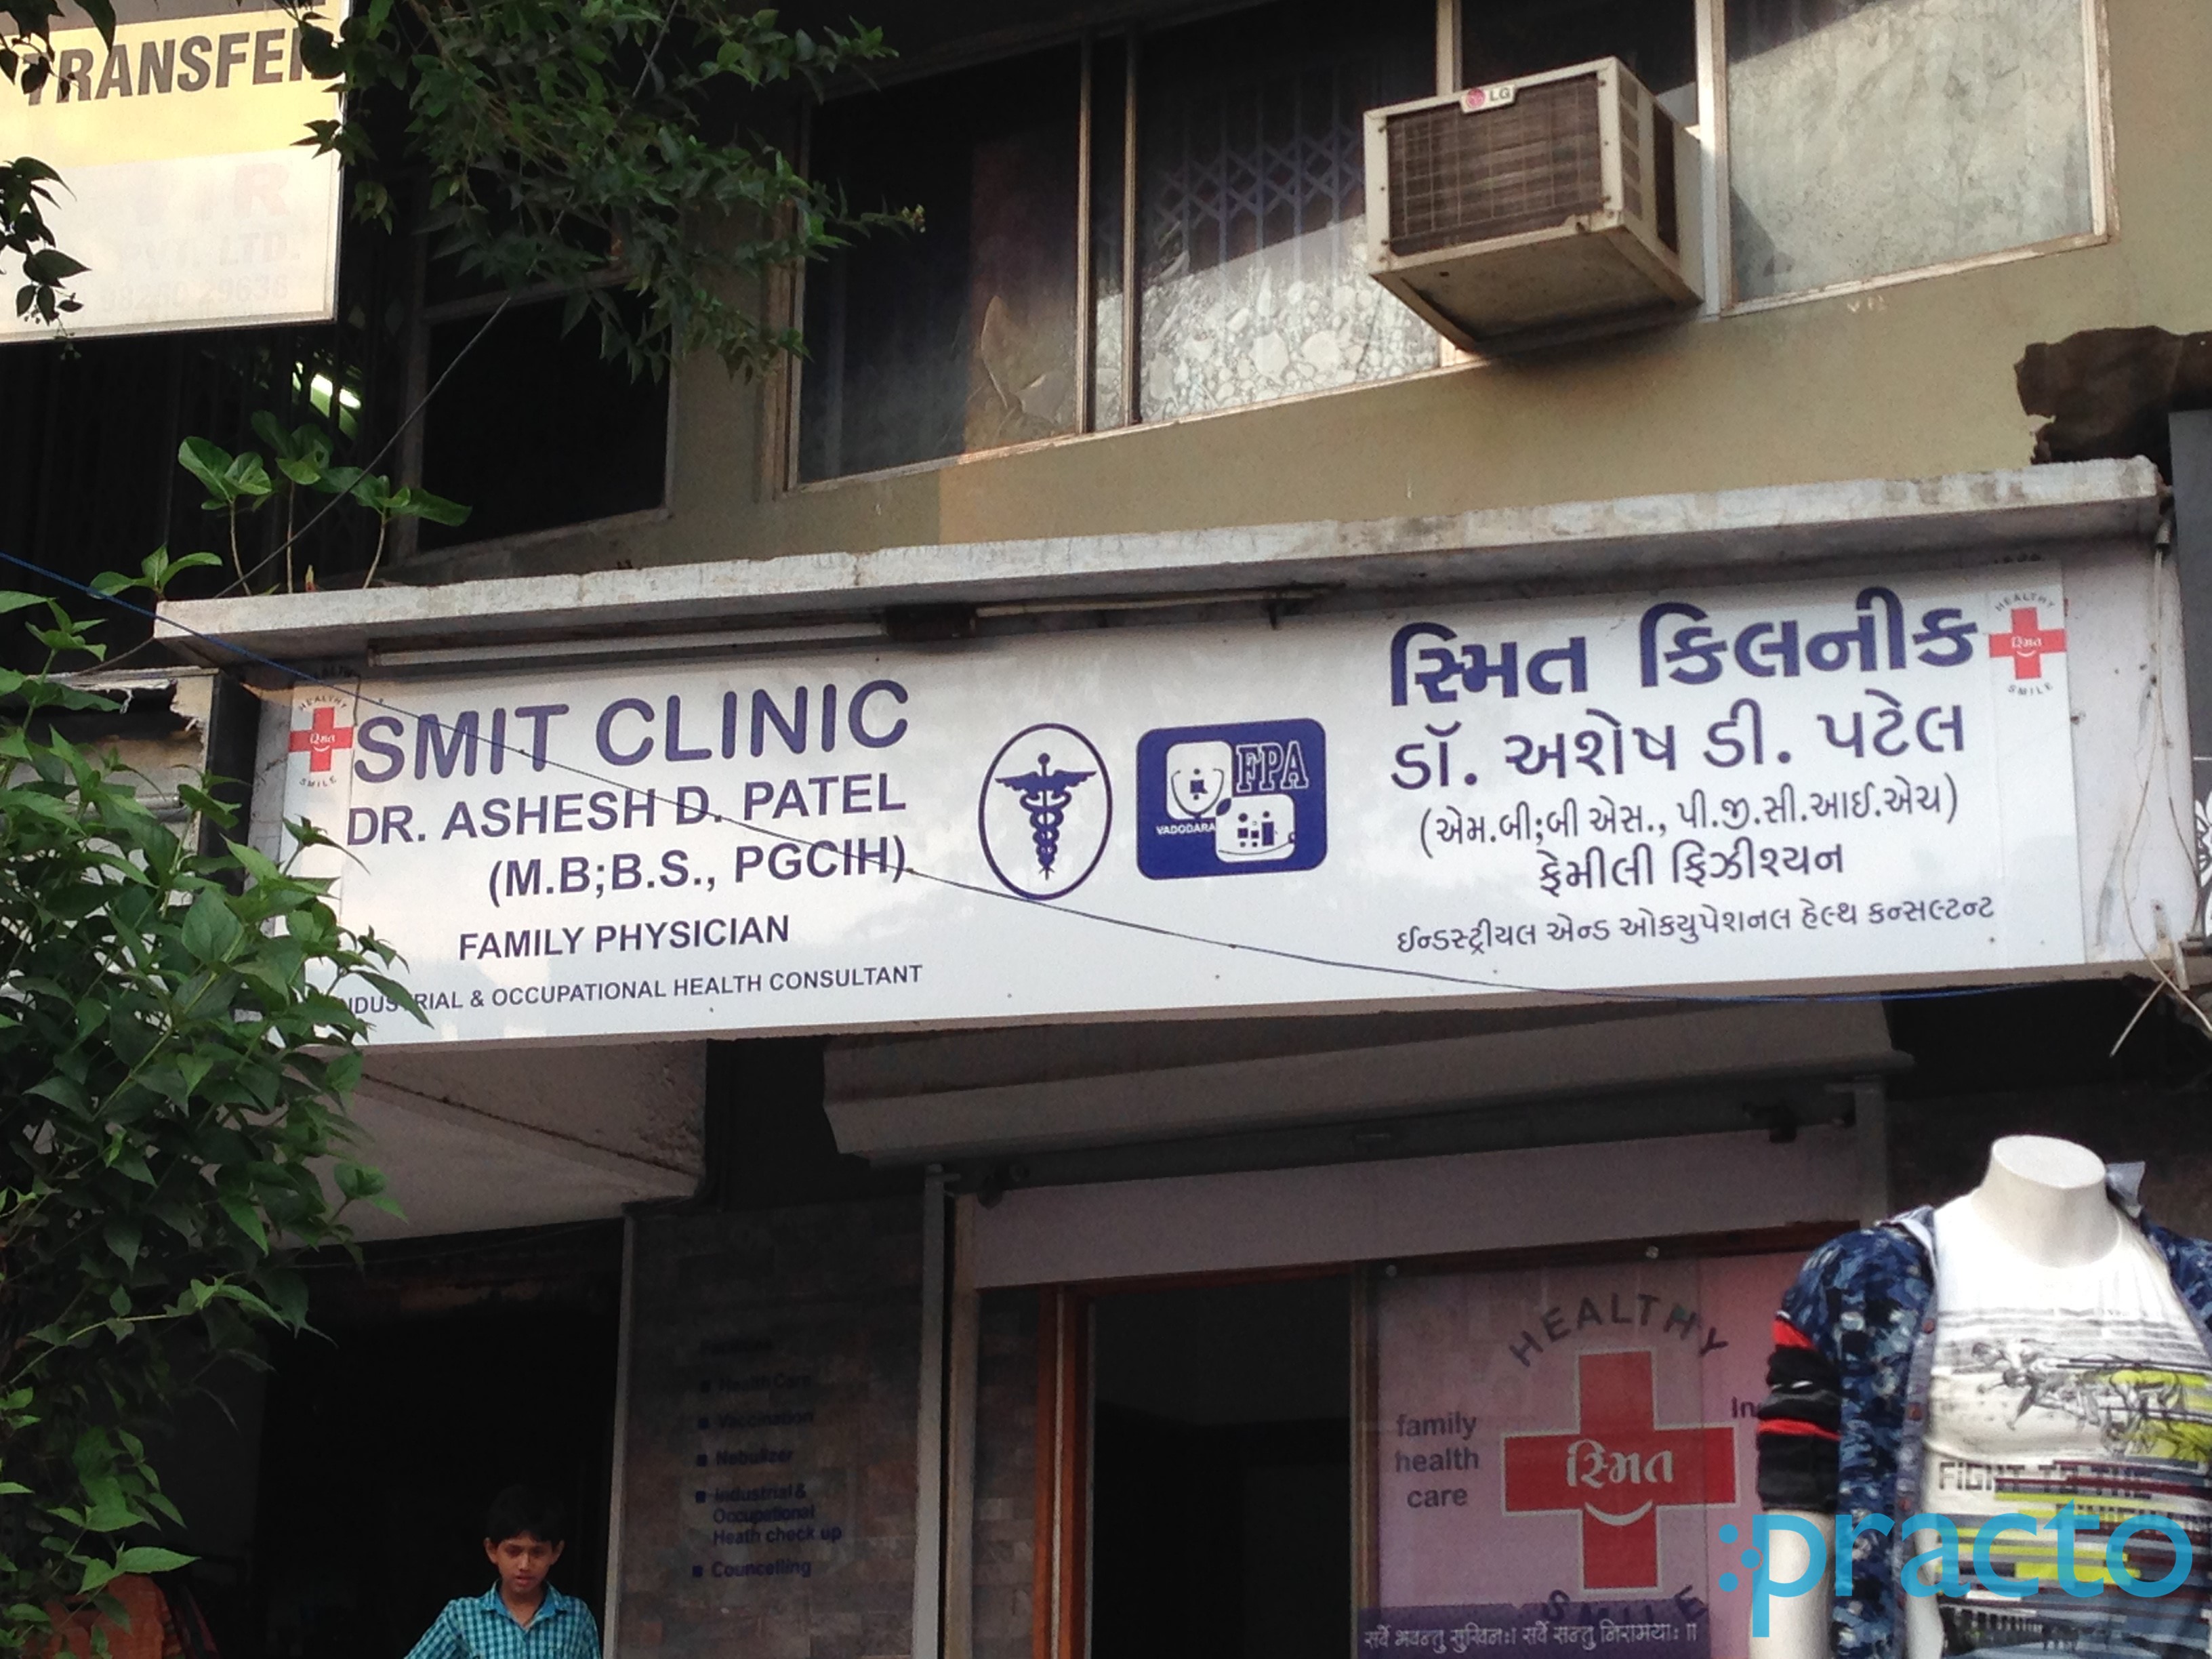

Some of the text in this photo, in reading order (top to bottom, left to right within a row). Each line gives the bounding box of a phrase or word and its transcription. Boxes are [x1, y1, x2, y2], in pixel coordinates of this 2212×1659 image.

[1490, 87, 1511, 101] LG
[354, 679, 909, 783] SMIT CLINIC
[1504, 708, 1677, 779] અશેષ
[1703, 698, 1791, 768] ડી.
[1817, 689, 1965, 758] પટેલ
[1235, 741, 1309, 794] FPA
[347, 805, 426, 846] DR.
[442, 788, 656, 840] ASHESH
[744, 773, 907, 821] PATEL
[1155, 823, 1216, 836] VADODARA
[735, 835, 906, 884] PGCIH)
[1536, 842, 1654, 897] ફેમીલી
[459, 915, 790, 960] FAMILY PHYSICIAN
[1547, 913, 1610, 942] એન્ડ
[1799, 898, 1857, 928] હેલ્થ
[349, 964, 923, 1015] DUSRIAL & OCCUPATIONAL HEALTH CONSULTANT
[1509, 1292, 1729, 1368] HEALTHY
[1397, 1412, 1477, 1441] family
[1395, 1448, 1479, 1473] health
[1407, 1487, 1469, 1509] care
[821, 1526, 843, 1543] up
